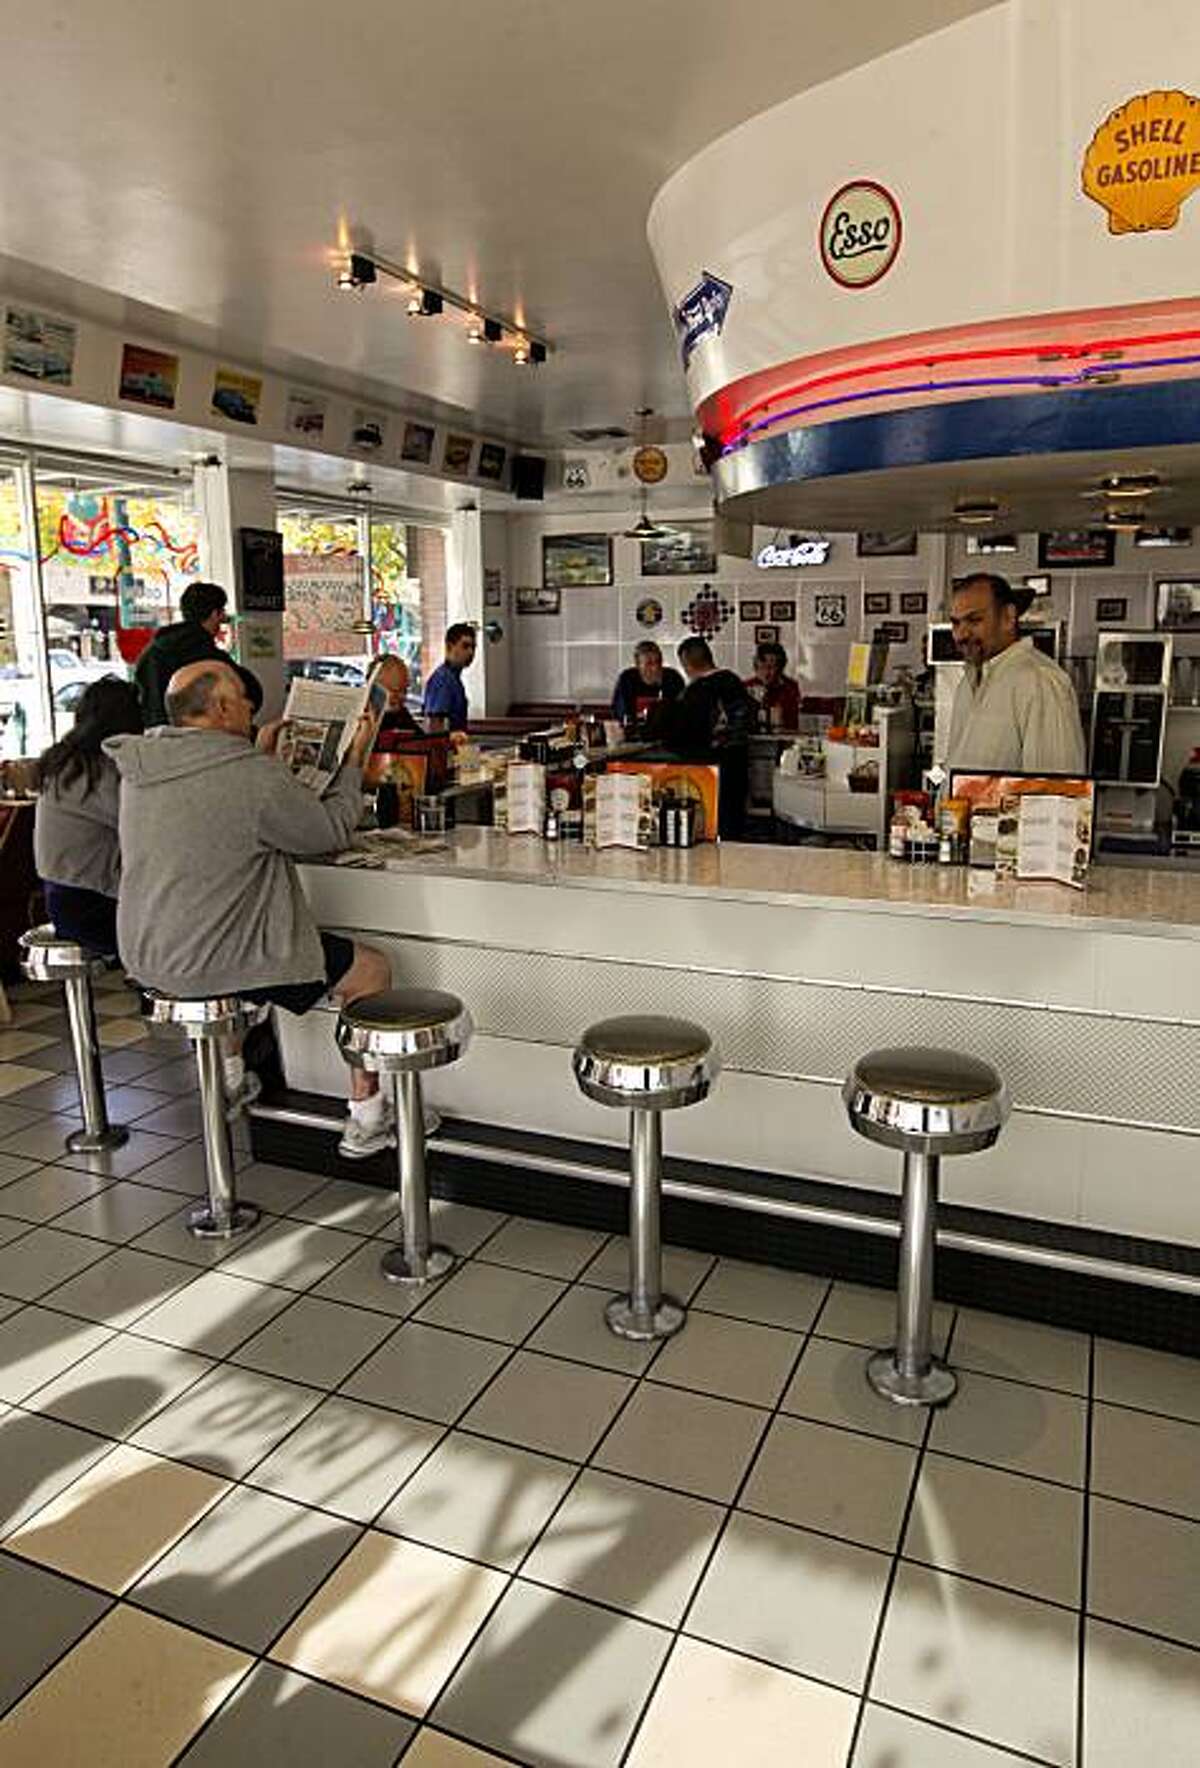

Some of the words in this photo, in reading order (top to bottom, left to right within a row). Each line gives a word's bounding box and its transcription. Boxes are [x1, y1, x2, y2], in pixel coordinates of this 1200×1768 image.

[1114, 118, 1186, 154] SHELL
[1096, 152, 1200, 188] GASOLINE
[829, 211, 890, 260] Esso
[565, 468, 586, 488] 66
[820, 606, 842, 622] 66
